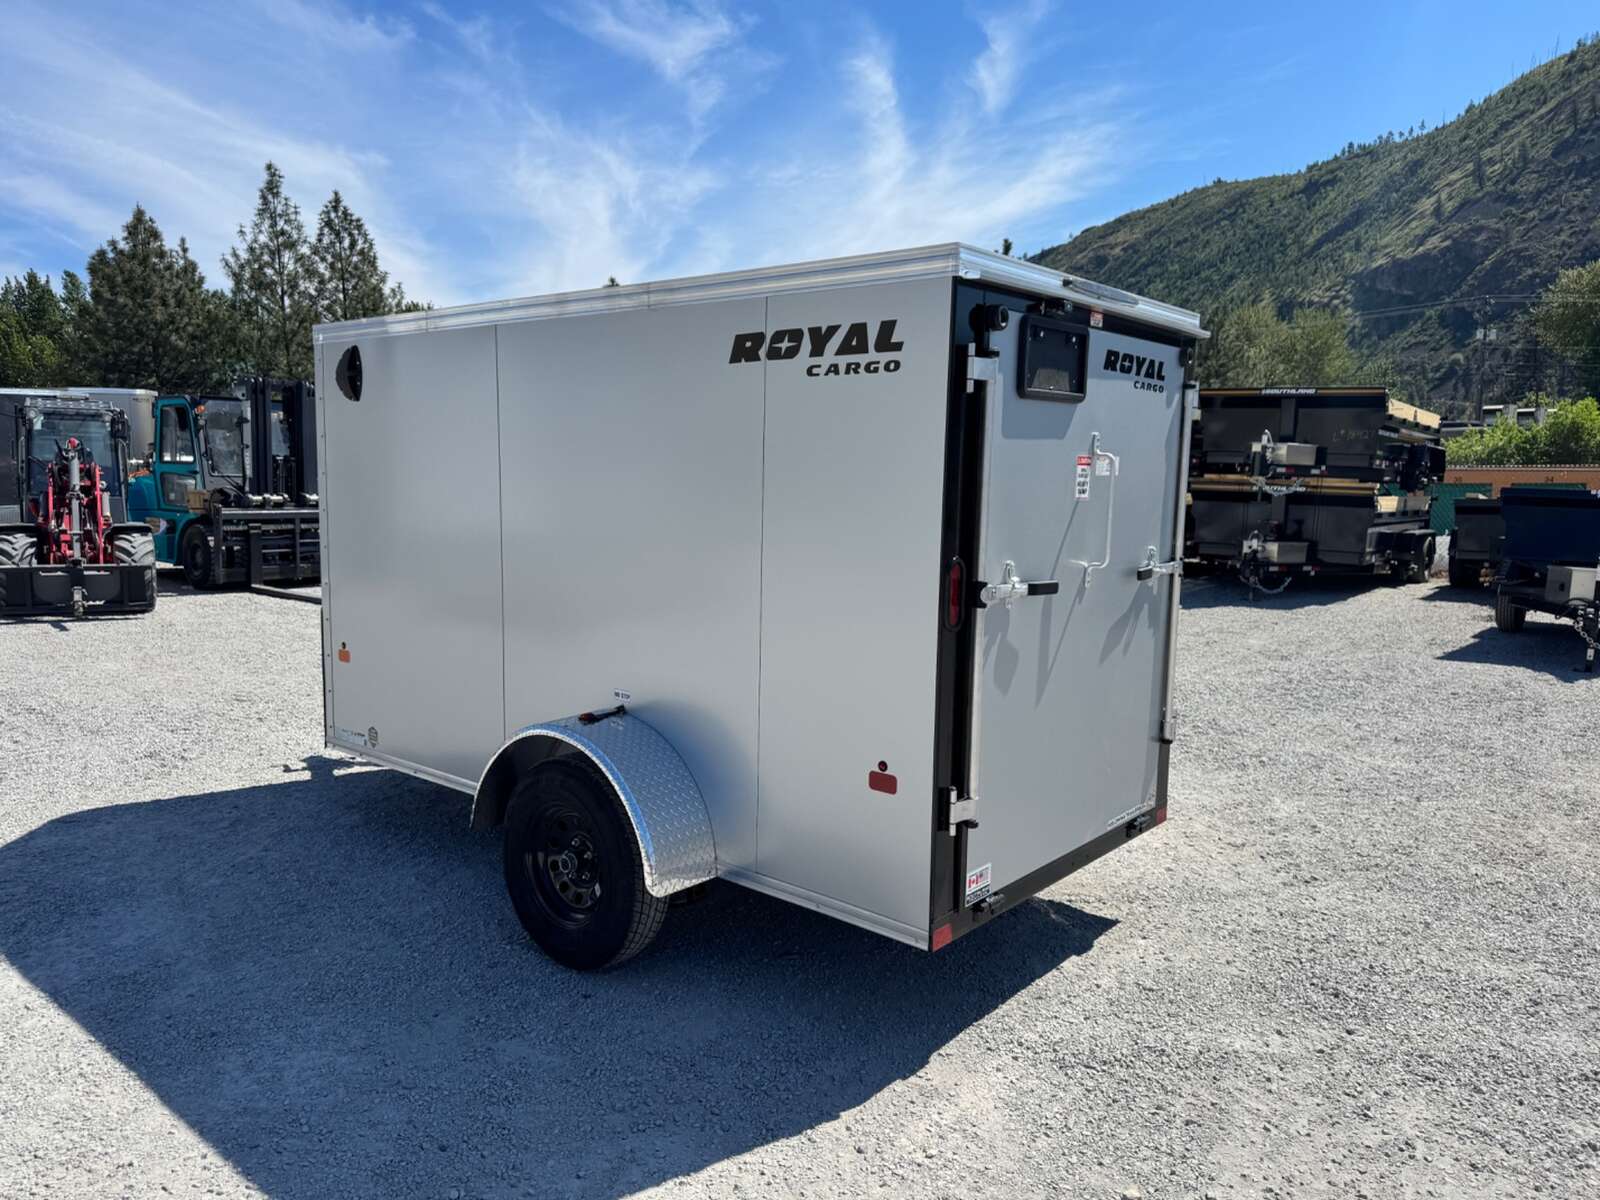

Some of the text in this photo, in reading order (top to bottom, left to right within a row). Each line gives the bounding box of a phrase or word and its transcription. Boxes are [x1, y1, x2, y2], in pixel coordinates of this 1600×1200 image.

[729, 319, 904, 364] ROYAL
[806, 360, 901, 377] CARGO
[1103, 349, 1166, 381] ROYAL
[1133, 381, 1165, 393] CARGO
